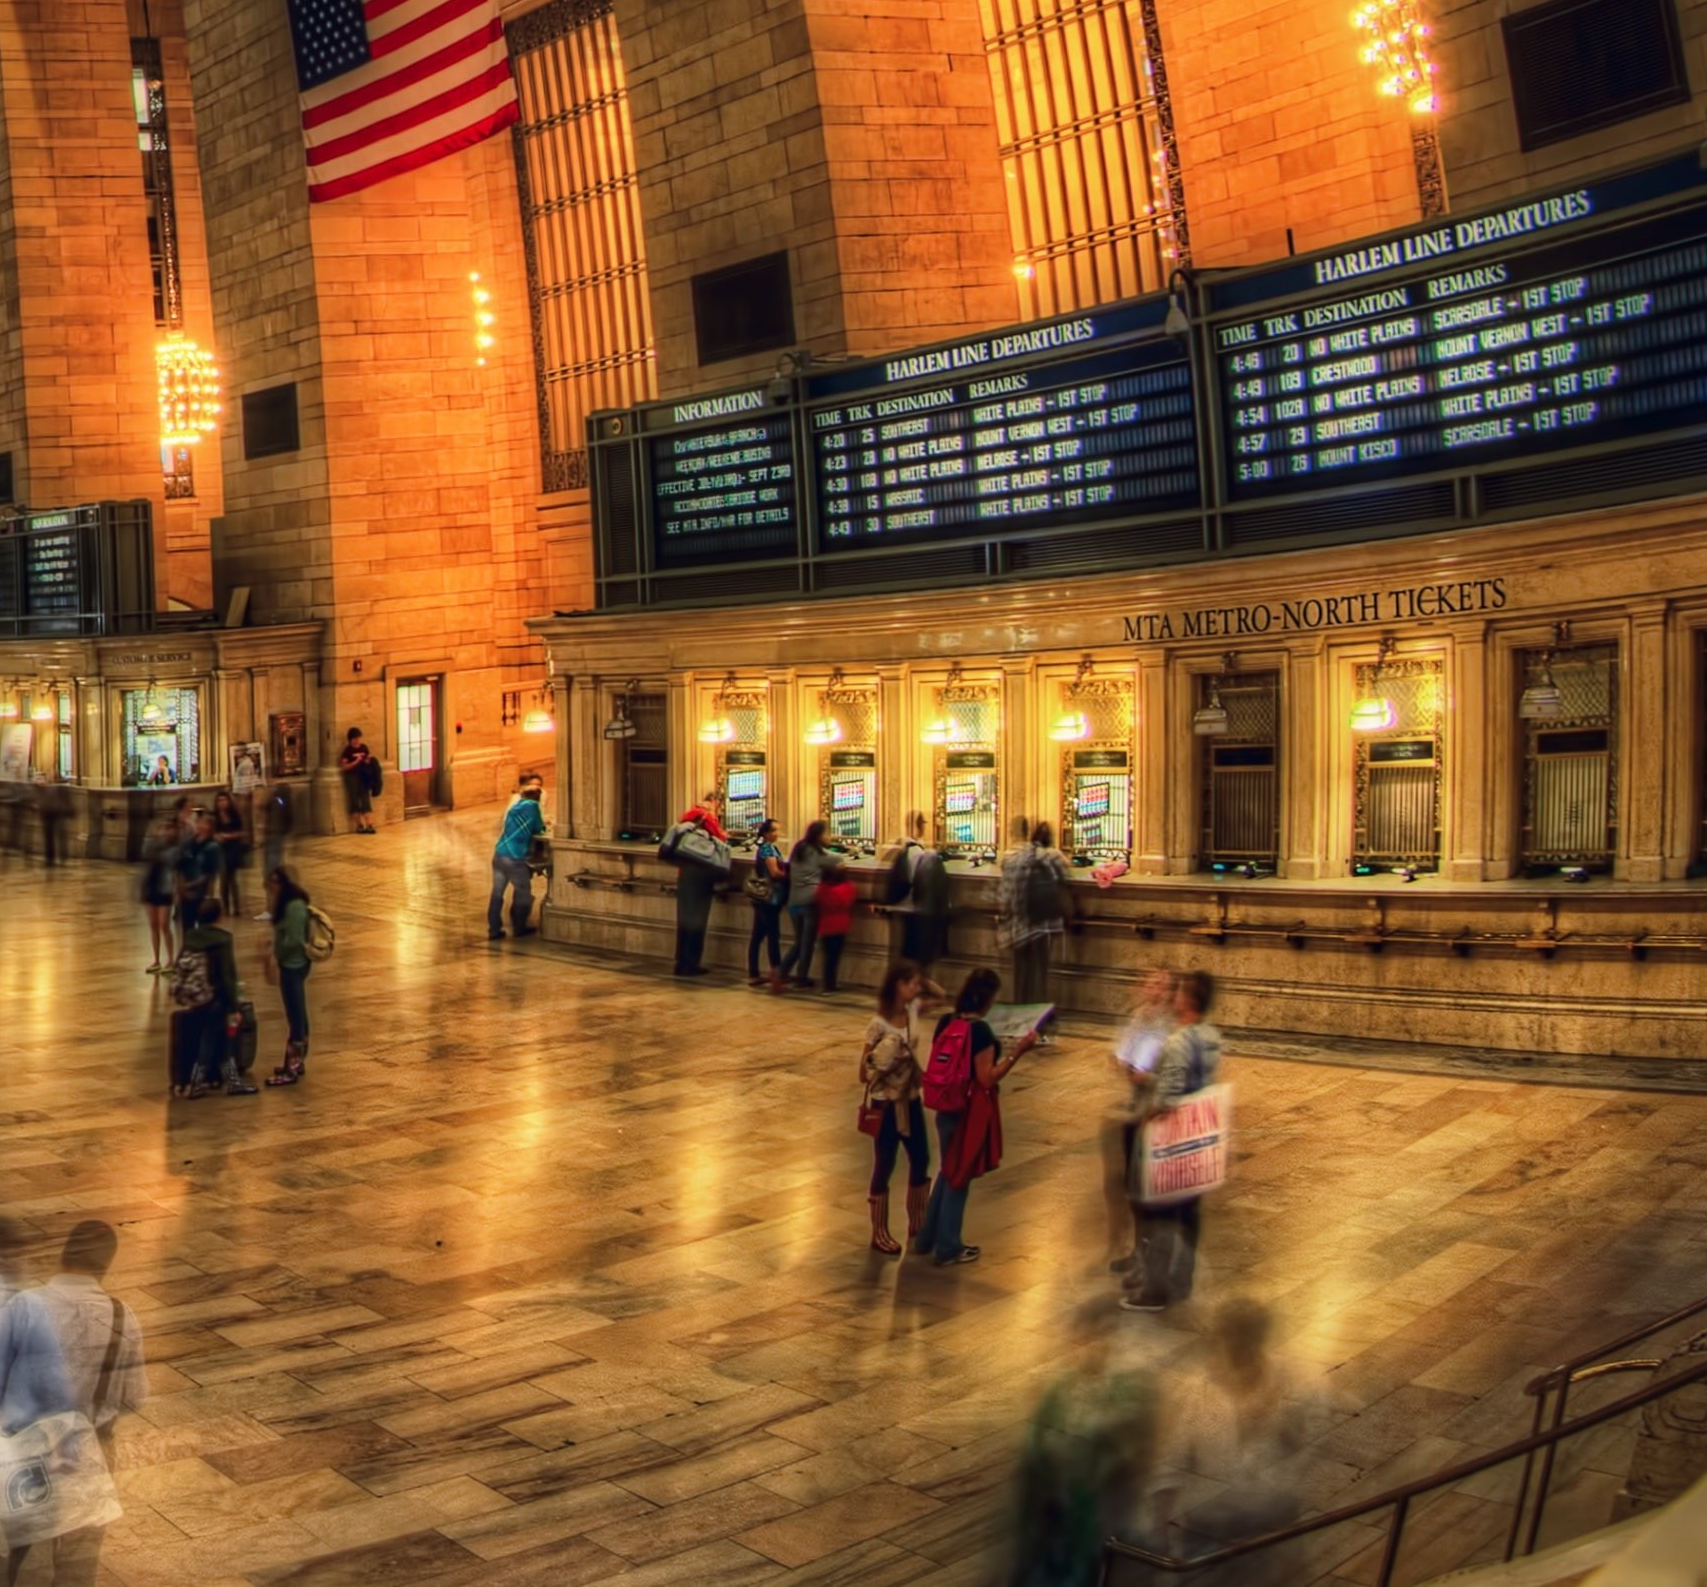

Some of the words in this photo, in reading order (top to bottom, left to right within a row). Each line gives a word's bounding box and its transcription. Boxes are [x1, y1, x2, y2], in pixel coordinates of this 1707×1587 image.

[1315, 241, 1401, 284] HARLEM
[1404, 228, 1454, 262] LINE
[1455, 189, 1592, 248] DEPARTURES
[1219, 322, 1257, 348] TIME
[1263, 312, 1298, 337] TRK
[1303, 286, 1407, 328] DESTINATION
[1427, 261, 1507, 299] REMARKS
[1229, 350, 1262, 375] 4:46
[1282, 342, 1299, 363] 20
[1308, 335, 1327, 357] NO
[1329, 326, 1368, 353] WHITE
[1369, 314, 1417, 344] PLAINS
[1432, 294, 1504, 329] SCARSDALE
[1522, 284, 1548, 309] 1ST
[1550, 275, 1587, 303] STOP
[887, 349, 951, 382] HARLEM
[953, 343, 990, 368] LINE
[992, 317, 1095, 359] DEPARTURES
[1311, 352, 1378, 385] CRESTWOOD
[1435, 330, 1476, 358] MOUNT
[1479, 319, 1528, 349] VERNON
[1531, 311, 1566, 338] WEST
[1585, 301, 1611, 326] 1ST
[1614, 292, 1653, 320] STOP
[674, 390, 764, 423] INFORMATION
[814, 409, 841, 427] TIME
[846, 403, 872, 421] TRK
[876, 387, 953, 416] DESTINATION
[968, 372, 1028, 399] REMARKS
[822, 431, 845, 450] 4:20
[860, 426, 874, 443] 25
[880, 416, 930, 440] SOUTHEAST
[972, 402, 1004, 424] WHITE
[1005, 395, 1044, 418] PLAINS
[1057, 389, 1077, 409] 1ST
[1079, 384, 1107, 405] STOP
[1234, 405, 1265, 429] 4:54
[1313, 391, 1332, 413] NO
[1333, 383, 1373, 409] WHITE
[1374, 372, 1423, 401] PLAINS
[1437, 357, 1495, 388] MELROSE
[1513, 348, 1539, 373] 1ST
[1541, 340, 1578, 367] STOP
[1235, 432, 1266, 455] 4:57
[1315, 410, 1382, 441] SOUTHEAST
[1439, 391, 1482, 417] WHITE
[1484, 380, 1536, 409] PLAINS
[1553, 372, 1579, 396] 1ST
[1581, 364, 1619, 391] STOP
[824, 454, 846, 472] 4:23
[881, 445, 895, 462] NO
[897, 440, 926, 460] WHITE
[927, 434, 963, 455] PLAINS
[974, 426, 1005, 447] MOUNT
[1007, 419, 1046, 442] VERNON
[1046, 415, 1073, 435] WEST
[1087, 409, 1108, 429] 1ST
[1109, 403, 1139, 425] STOP
[883, 468, 897, 485] NO
[898, 463, 928, 483] WHITE
[928, 457, 964, 478] PLAINS
[975, 448, 1019, 471] MELROSE
[1032, 443, 1052, 462] 1ST
[1053, 438, 1082, 458] STOP
[1238, 459, 1269, 481] 5:00
[1317, 444, 1355, 468] MOUNT
[1357, 436, 1400, 461] KISCO
[1441, 416, 1513, 447] SCARSDALE
[1532, 408, 1559, 432] 1ST
[1561, 401, 1597, 427] STOP
[657, 479, 696, 496] EFFECTIVE
[748, 467, 768, 483] SEPT
[828, 520, 850, 537] 4:43
[886, 508, 935, 530] SOUTHEAST
[978, 498, 1010, 517] WHITE
[1012, 492, 1051, 513] PLAINS
[1064, 488, 1085, 506] 1ST
[1086, 484, 1115, 503] STOP
[866, 493, 879, 510] 15
[977, 474, 1009, 494] WHITE
[1010, 468, 1050, 489] PLAINS
[1062, 463, 1083, 481] 1ST
[1084, 458, 1113, 478] STOP
[667, 521, 681, 534] SEE
[738, 512, 753, 526] FOR
[755, 507, 790, 523] DETAILS
[1123, 614, 1174, 642] MTA
[1182, 593, 1381, 636] METRO-NORTH
[1389, 578, 1507, 617] TICKETS
